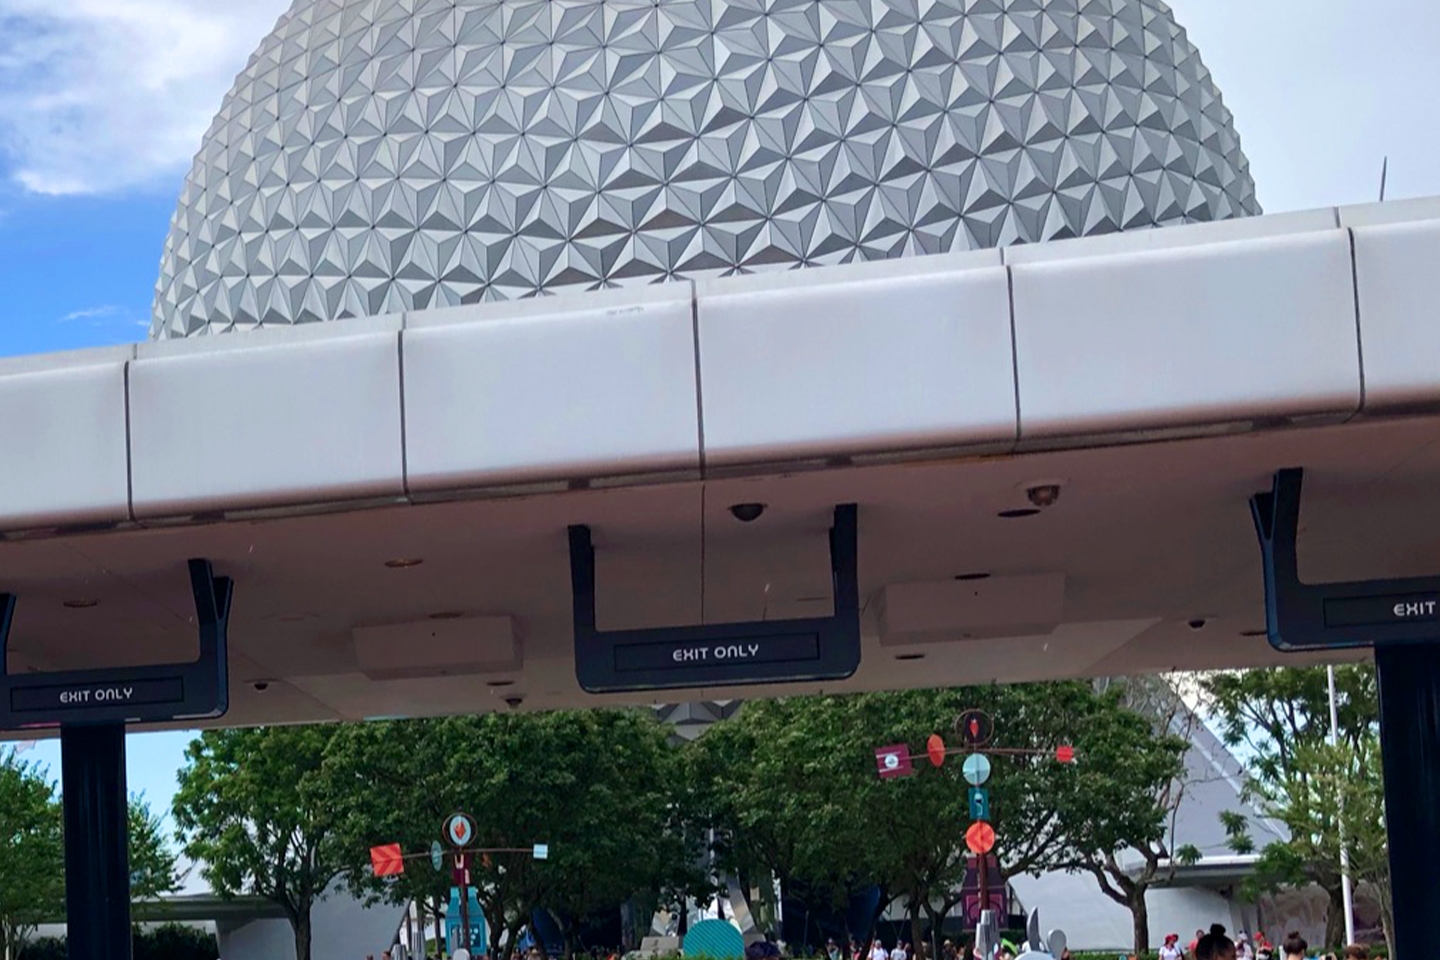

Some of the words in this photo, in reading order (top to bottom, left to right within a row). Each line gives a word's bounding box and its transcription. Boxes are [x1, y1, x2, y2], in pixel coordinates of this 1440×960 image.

[1393, 601, 1436, 616] EXIT
[672, 647, 709, 662] EXIT
[714, 644, 759, 659] ONLY
[60, 689, 91, 703] EXIT
[95, 687, 133, 700] ONLY
